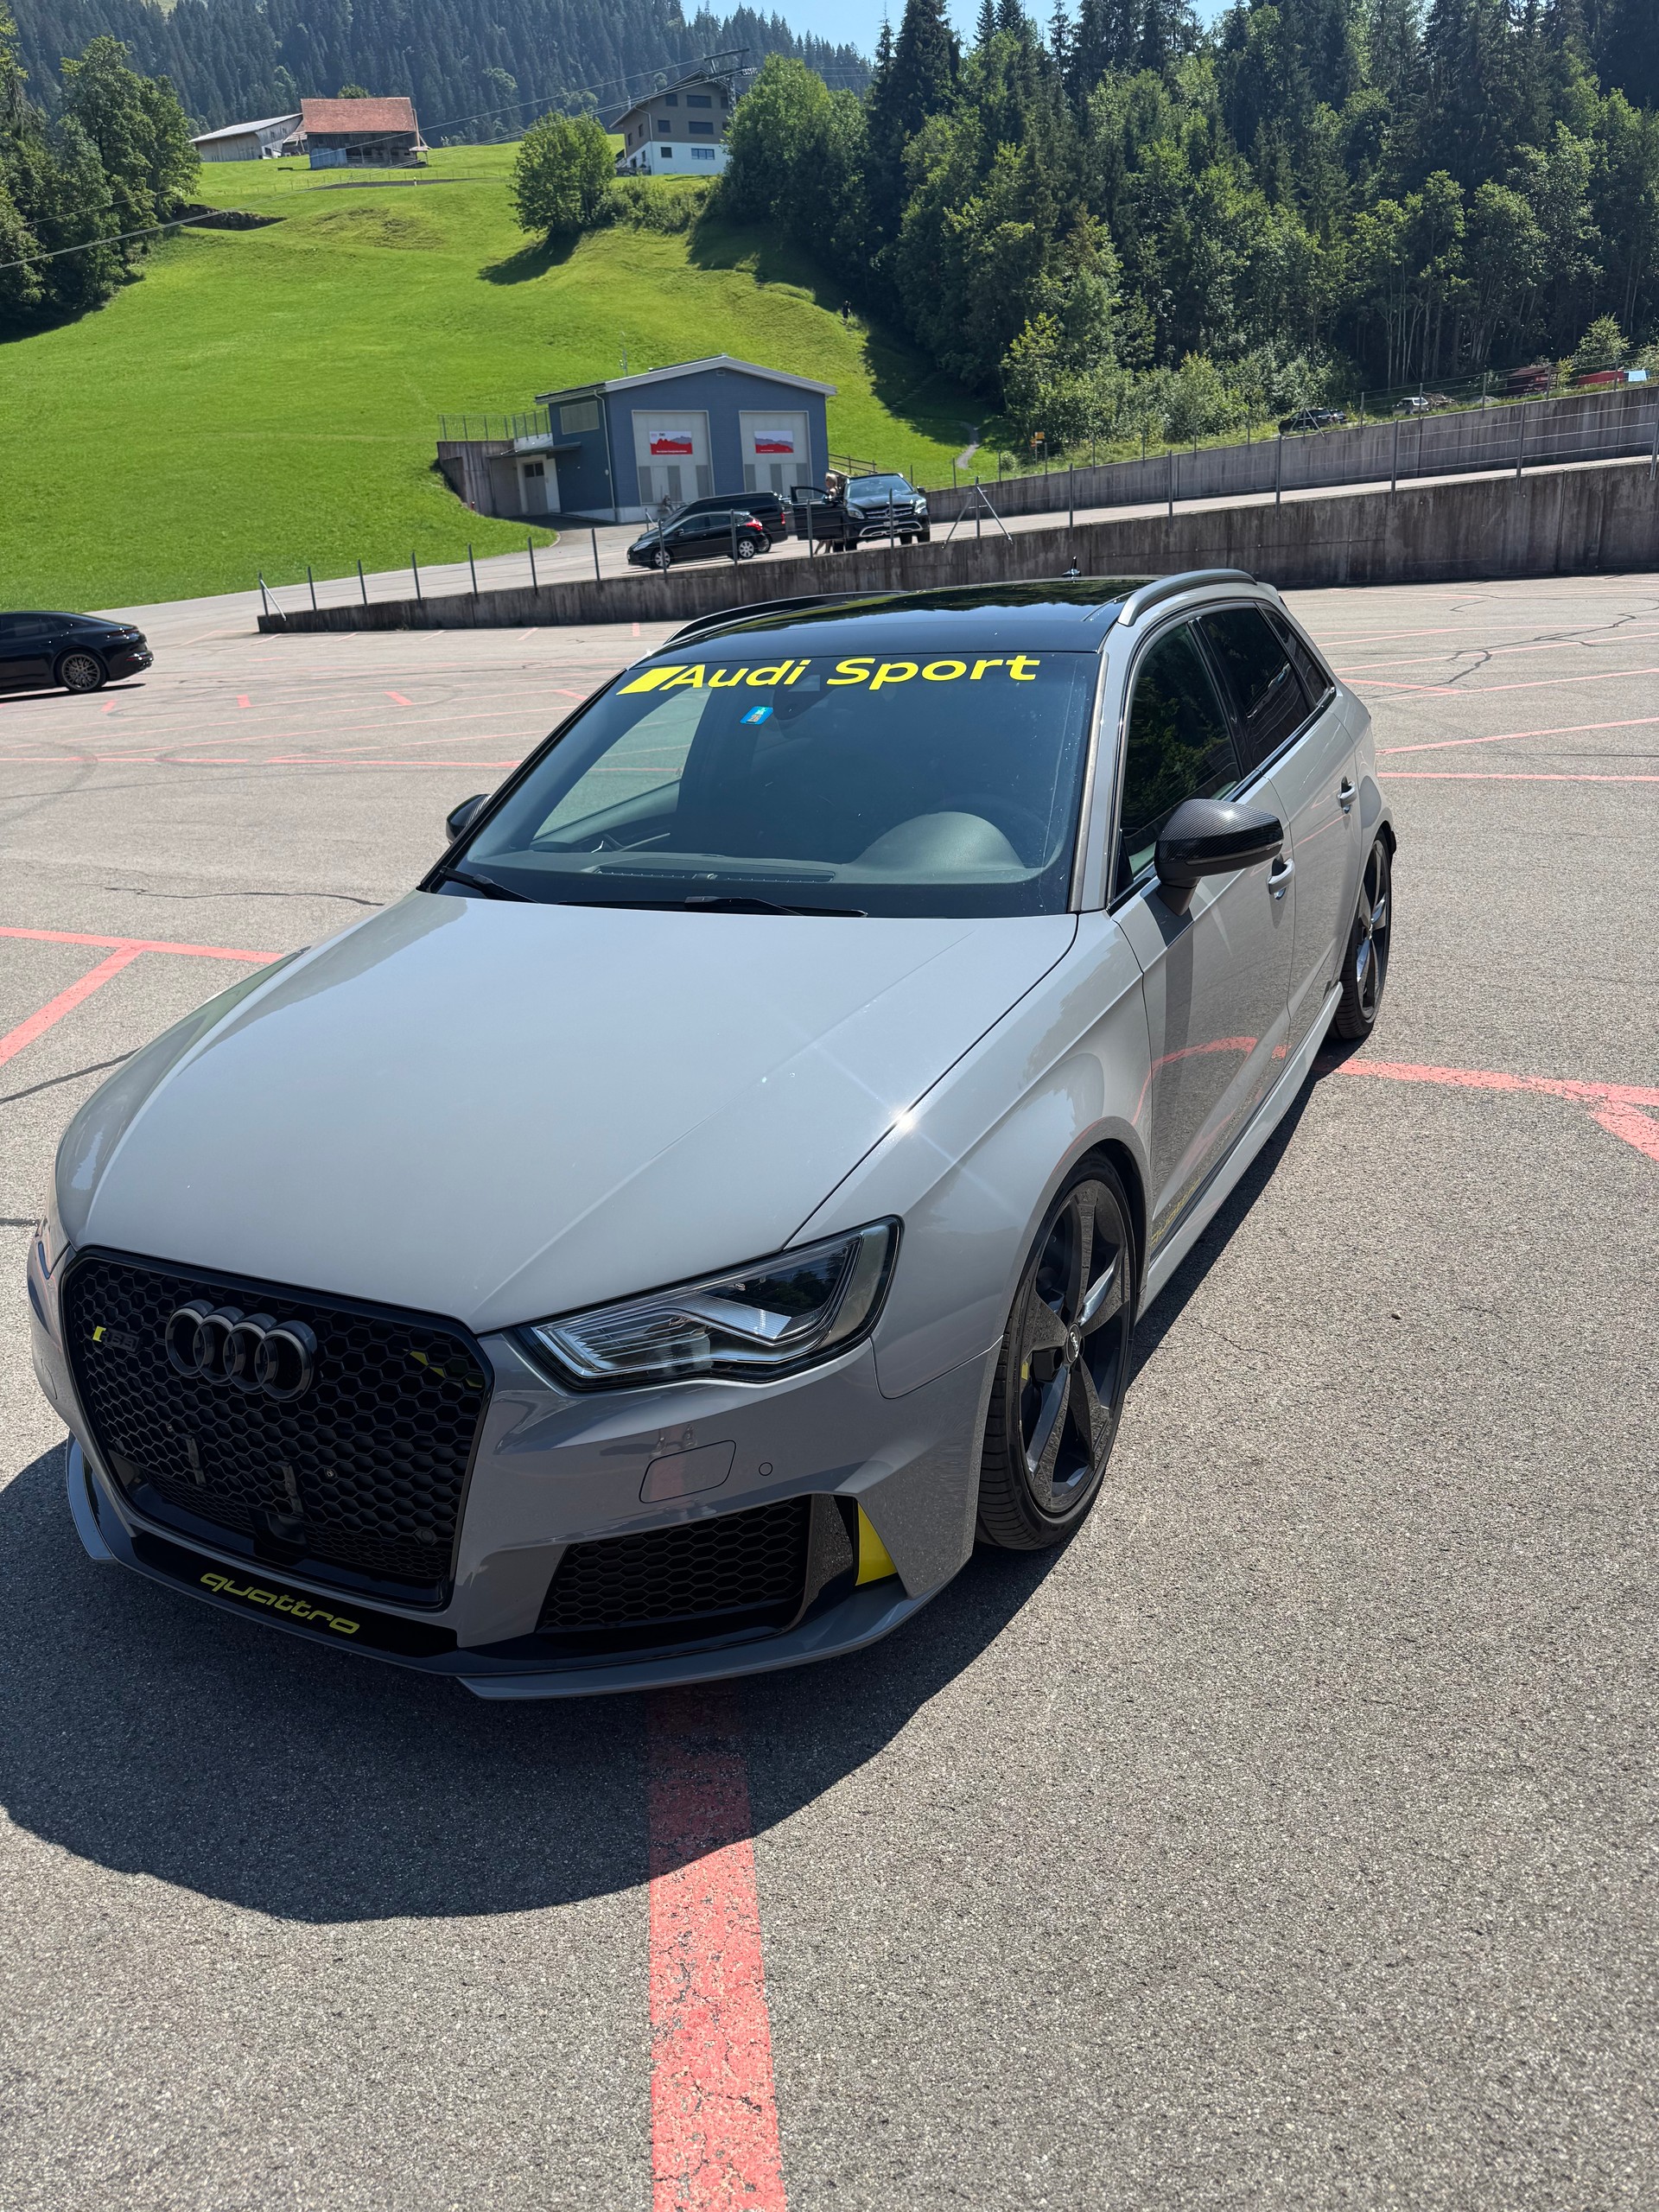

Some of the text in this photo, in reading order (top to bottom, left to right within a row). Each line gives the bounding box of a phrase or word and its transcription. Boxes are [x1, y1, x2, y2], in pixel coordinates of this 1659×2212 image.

[658, 654, 1041, 691] Audi Sport
[200, 1573, 360, 1634] quattro
